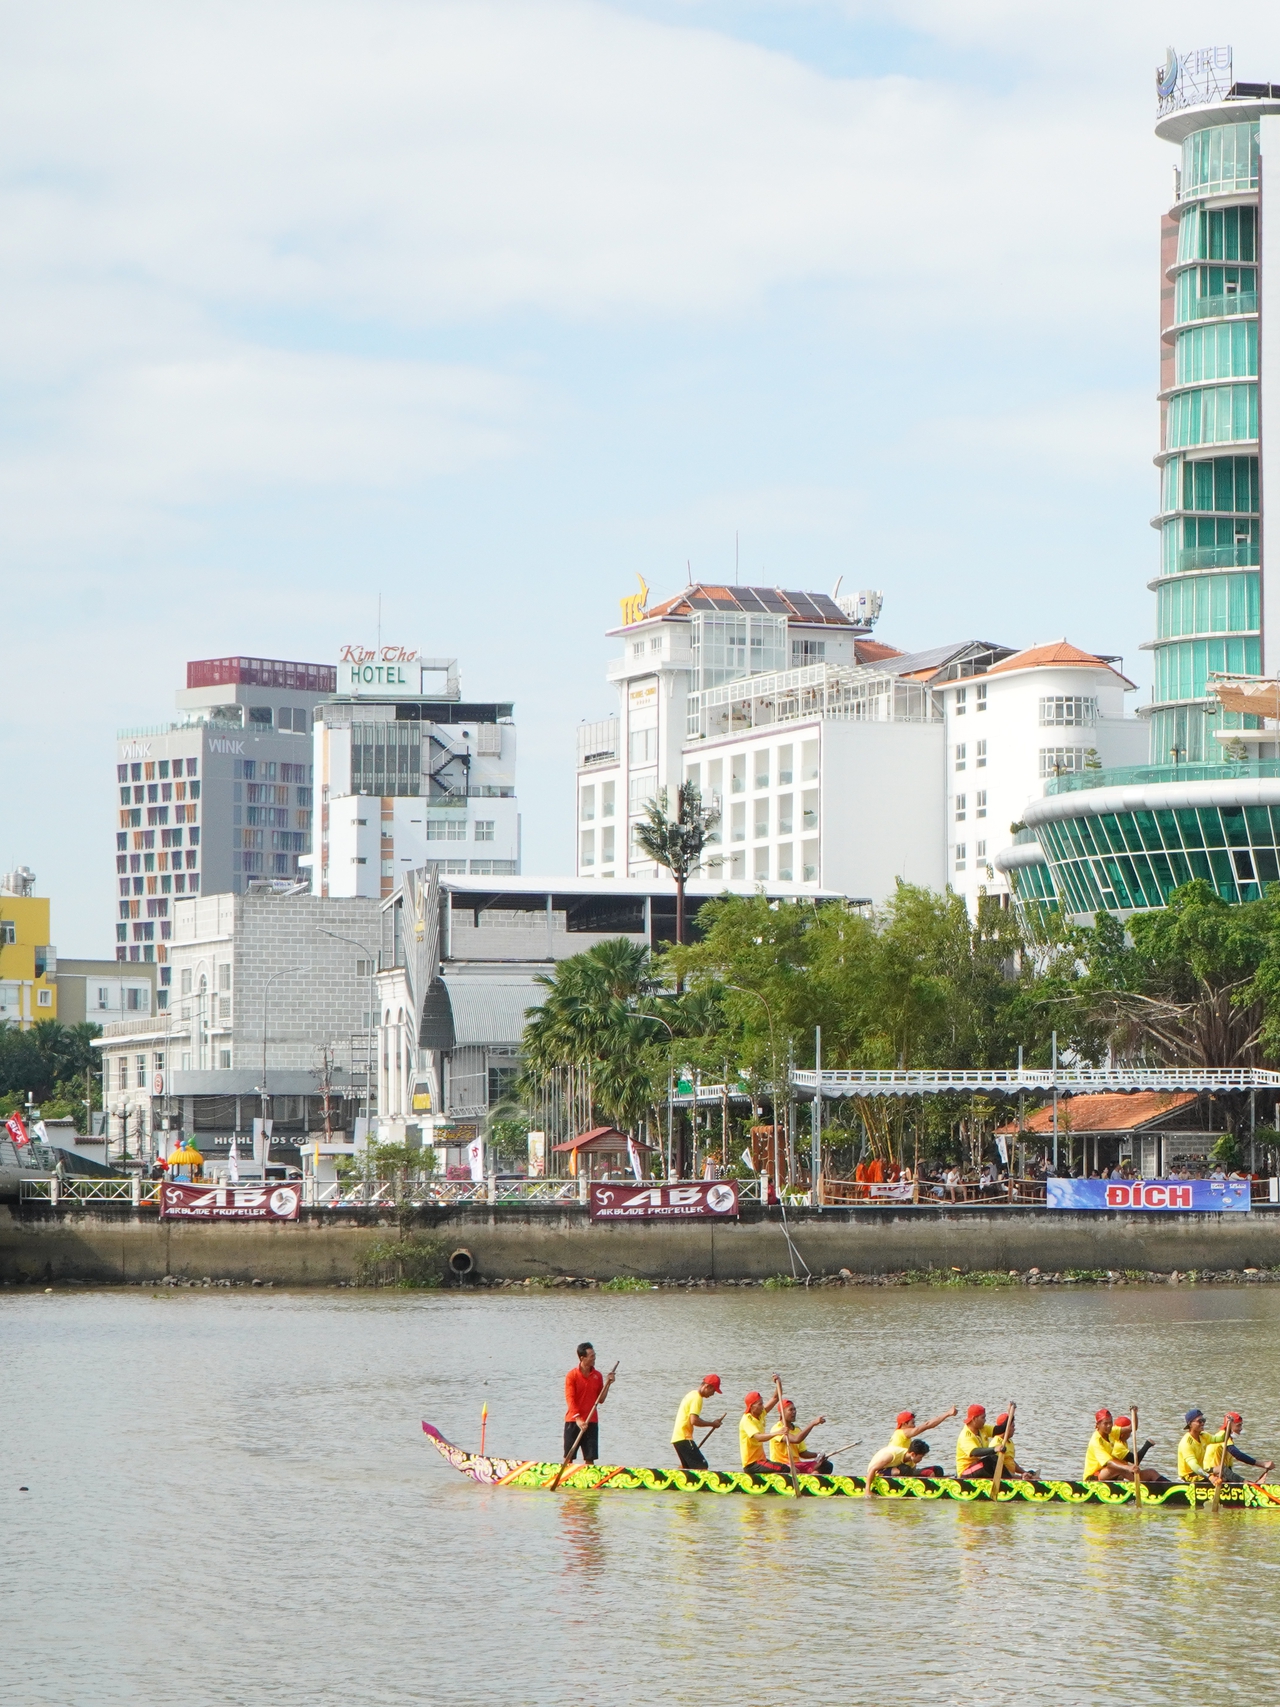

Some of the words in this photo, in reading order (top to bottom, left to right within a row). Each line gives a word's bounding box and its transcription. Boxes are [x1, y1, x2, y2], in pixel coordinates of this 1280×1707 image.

[620, 582, 649, 626] TTC
[340, 645, 376, 665] Kim
[351, 666, 406, 684] HOTEL
[214, 1136, 286, 1145] HIGHLDS
[189, 1188, 267, 1207] AB
[621, 1186, 703, 1206] AB
[1105, 1182, 1193, 1208] ĐÍCH
[165, 1207, 210, 1216] AIRBLADE
[213, 1207, 267, 1216] PROPELLER
[596, 1207, 644, 1216] AIRBLADE
[647, 1205, 704, 1214] PROPELLER
